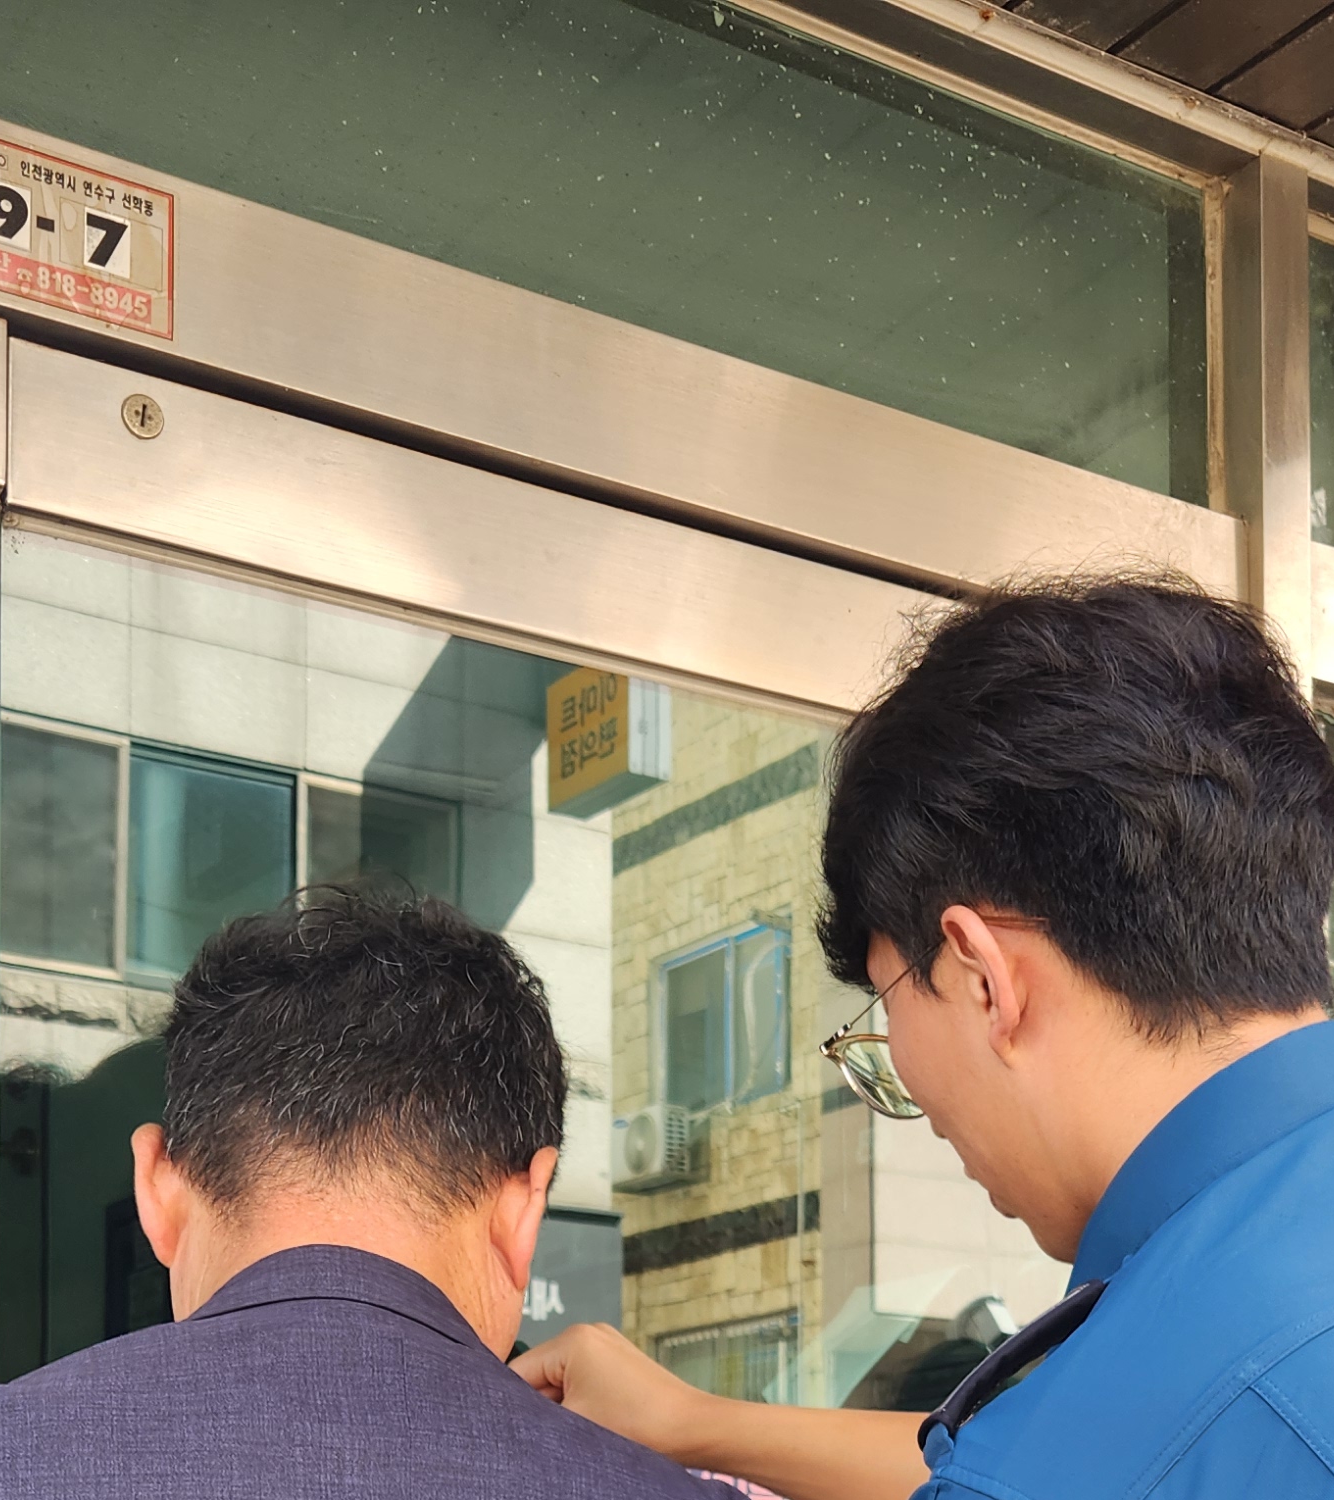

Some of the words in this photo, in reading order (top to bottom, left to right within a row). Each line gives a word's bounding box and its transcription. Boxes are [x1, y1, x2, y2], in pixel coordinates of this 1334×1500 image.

[20, 160, 77, 193] 인천광역시
[83, 180, 116, 204] 연수구
[121, 192, 155, 217] 선학동
[36, 265, 149, 317] 818-8945
